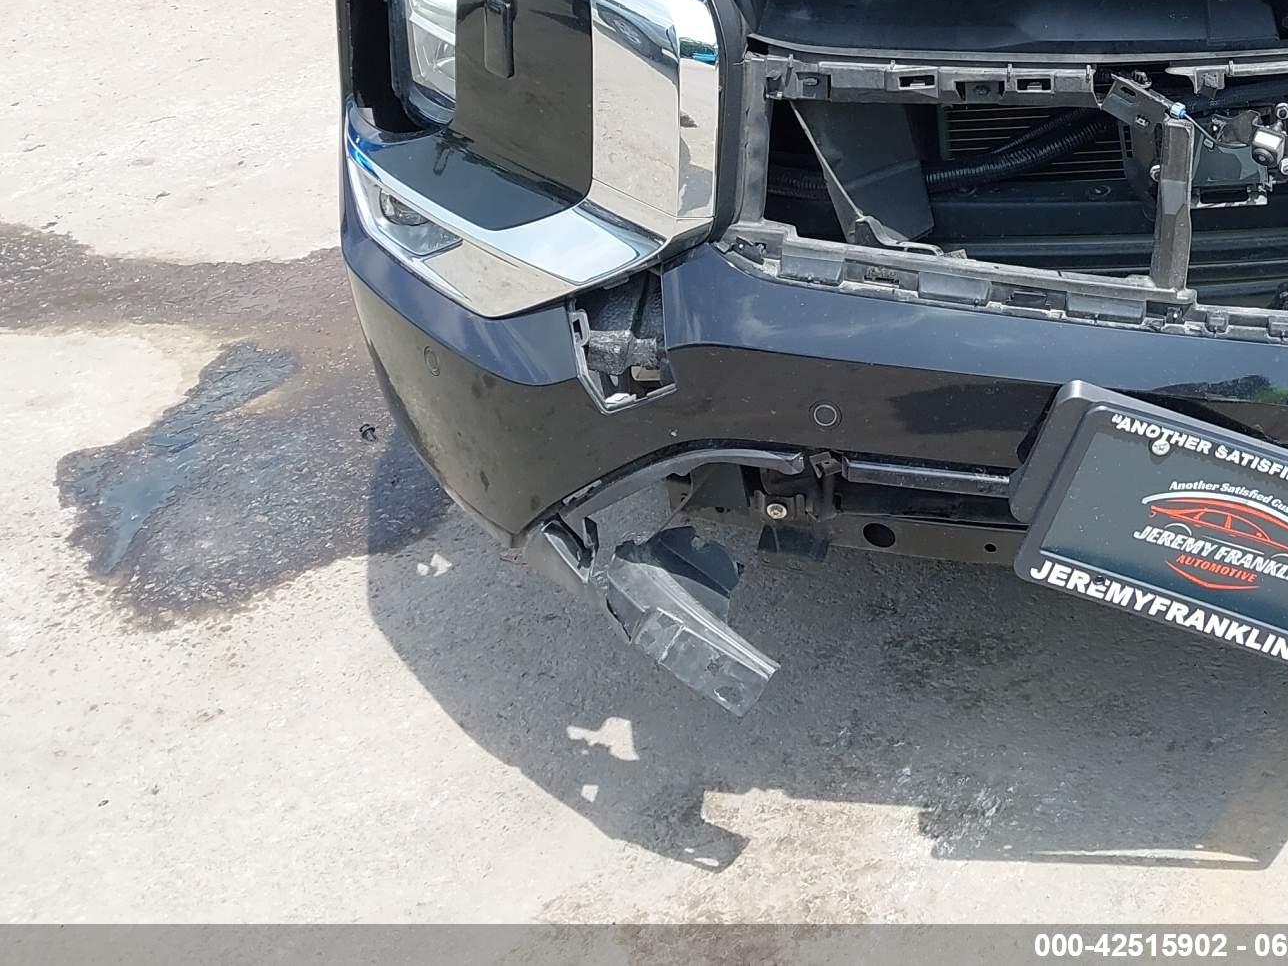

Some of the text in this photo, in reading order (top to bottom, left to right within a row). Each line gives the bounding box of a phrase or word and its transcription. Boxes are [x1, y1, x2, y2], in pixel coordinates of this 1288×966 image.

[1169, 480, 1220, 491] Another
[1220, 482, 1274, 504] Satisfied
[1133, 525, 1218, 558] JEREMY
[1176, 554, 1258, 583] AUTOMOTIVE
